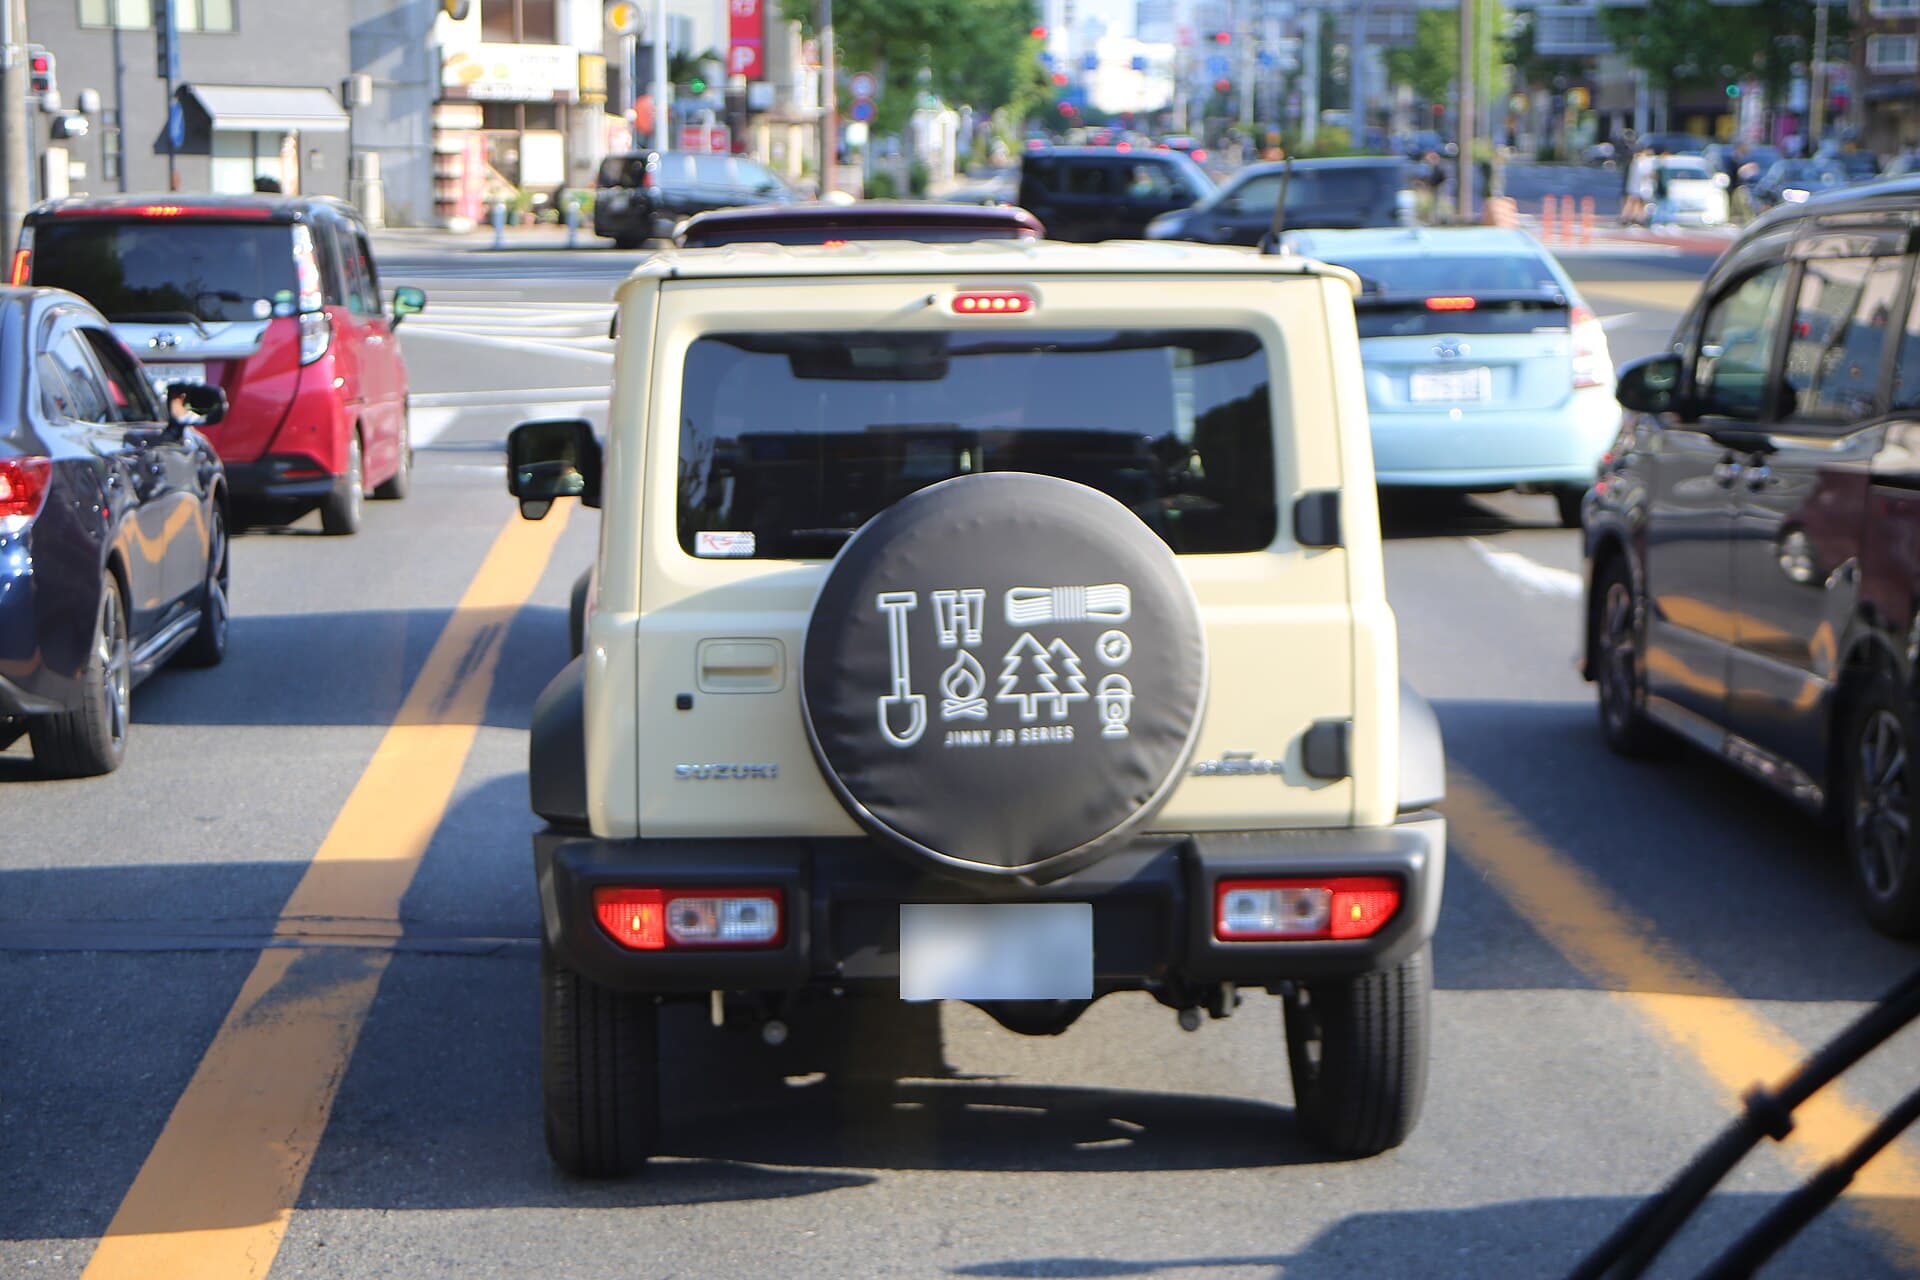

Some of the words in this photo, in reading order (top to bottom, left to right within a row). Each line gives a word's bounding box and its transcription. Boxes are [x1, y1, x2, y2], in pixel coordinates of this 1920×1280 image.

[996, 728, 1016, 747] JB
[1020, 725, 1074, 744] SERIES
[674, 763, 778, 780] SUZUKI
